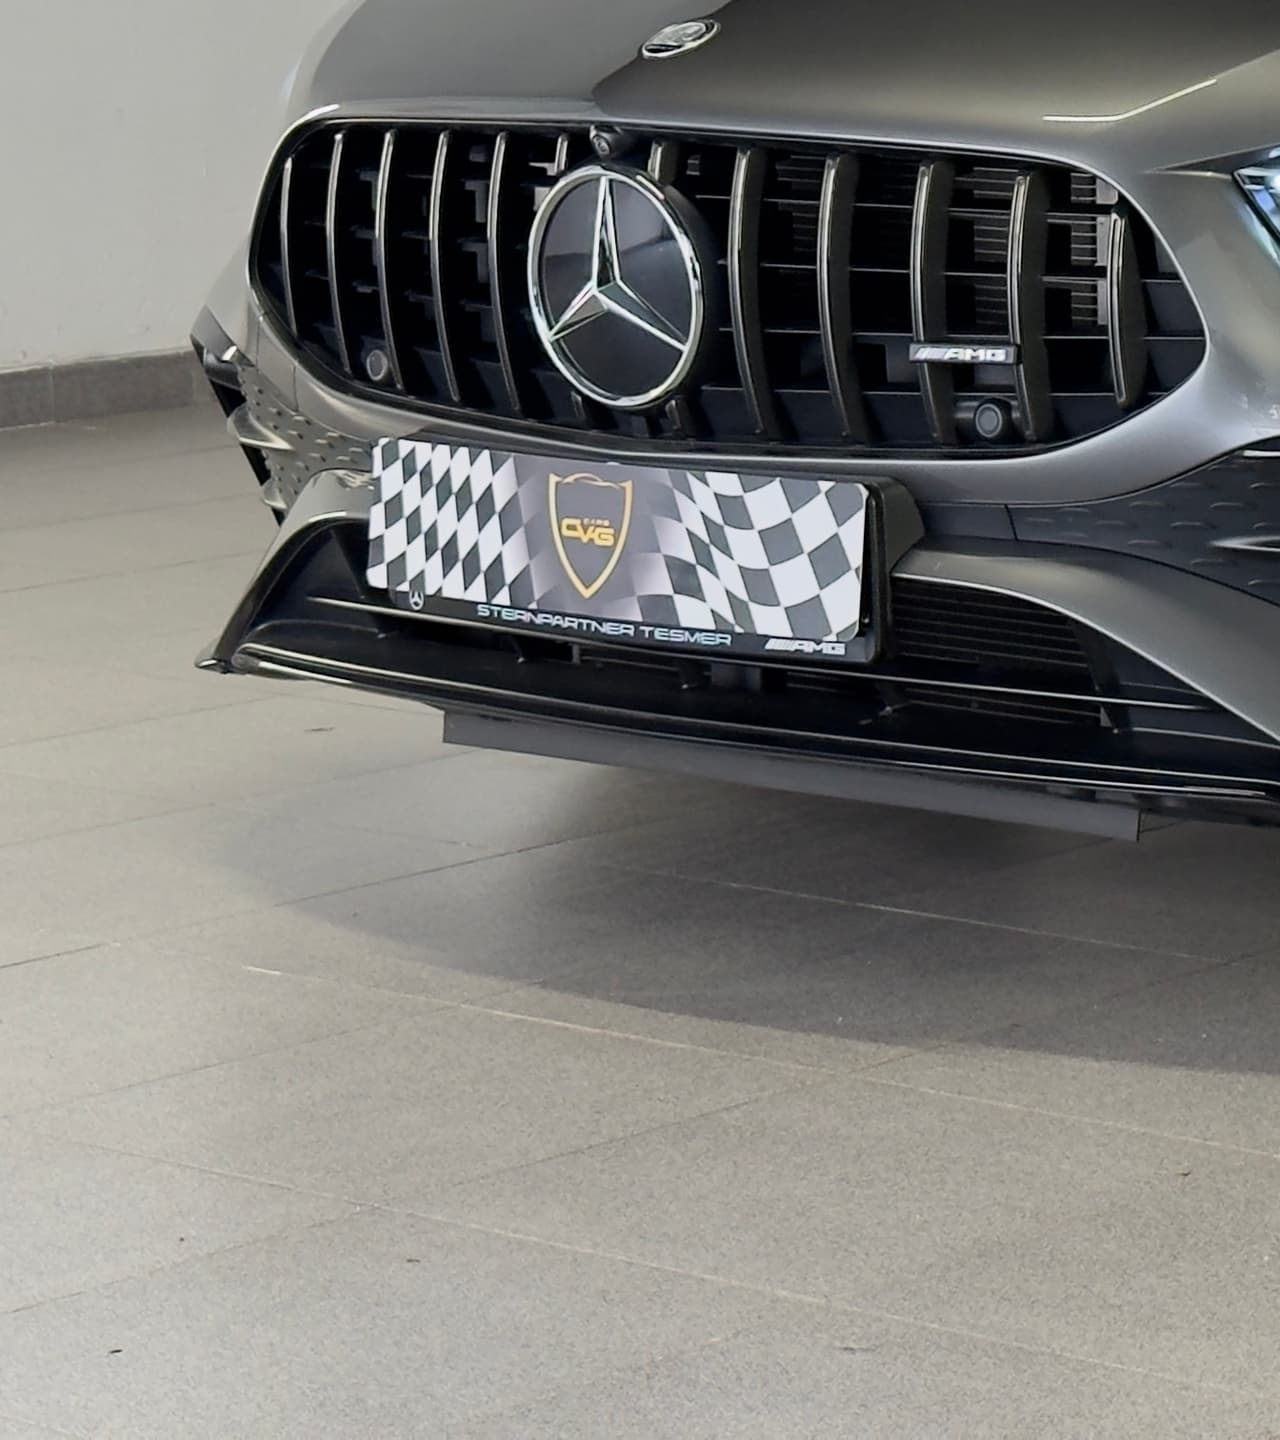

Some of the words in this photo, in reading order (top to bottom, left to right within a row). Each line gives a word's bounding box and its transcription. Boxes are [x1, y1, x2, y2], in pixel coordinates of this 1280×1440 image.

[943, 348, 1007, 361] AMG
[477, 604, 634, 636] STERNPARTNER
[639, 625, 732, 646] TESMER
[791, 640, 846, 656] AMG
